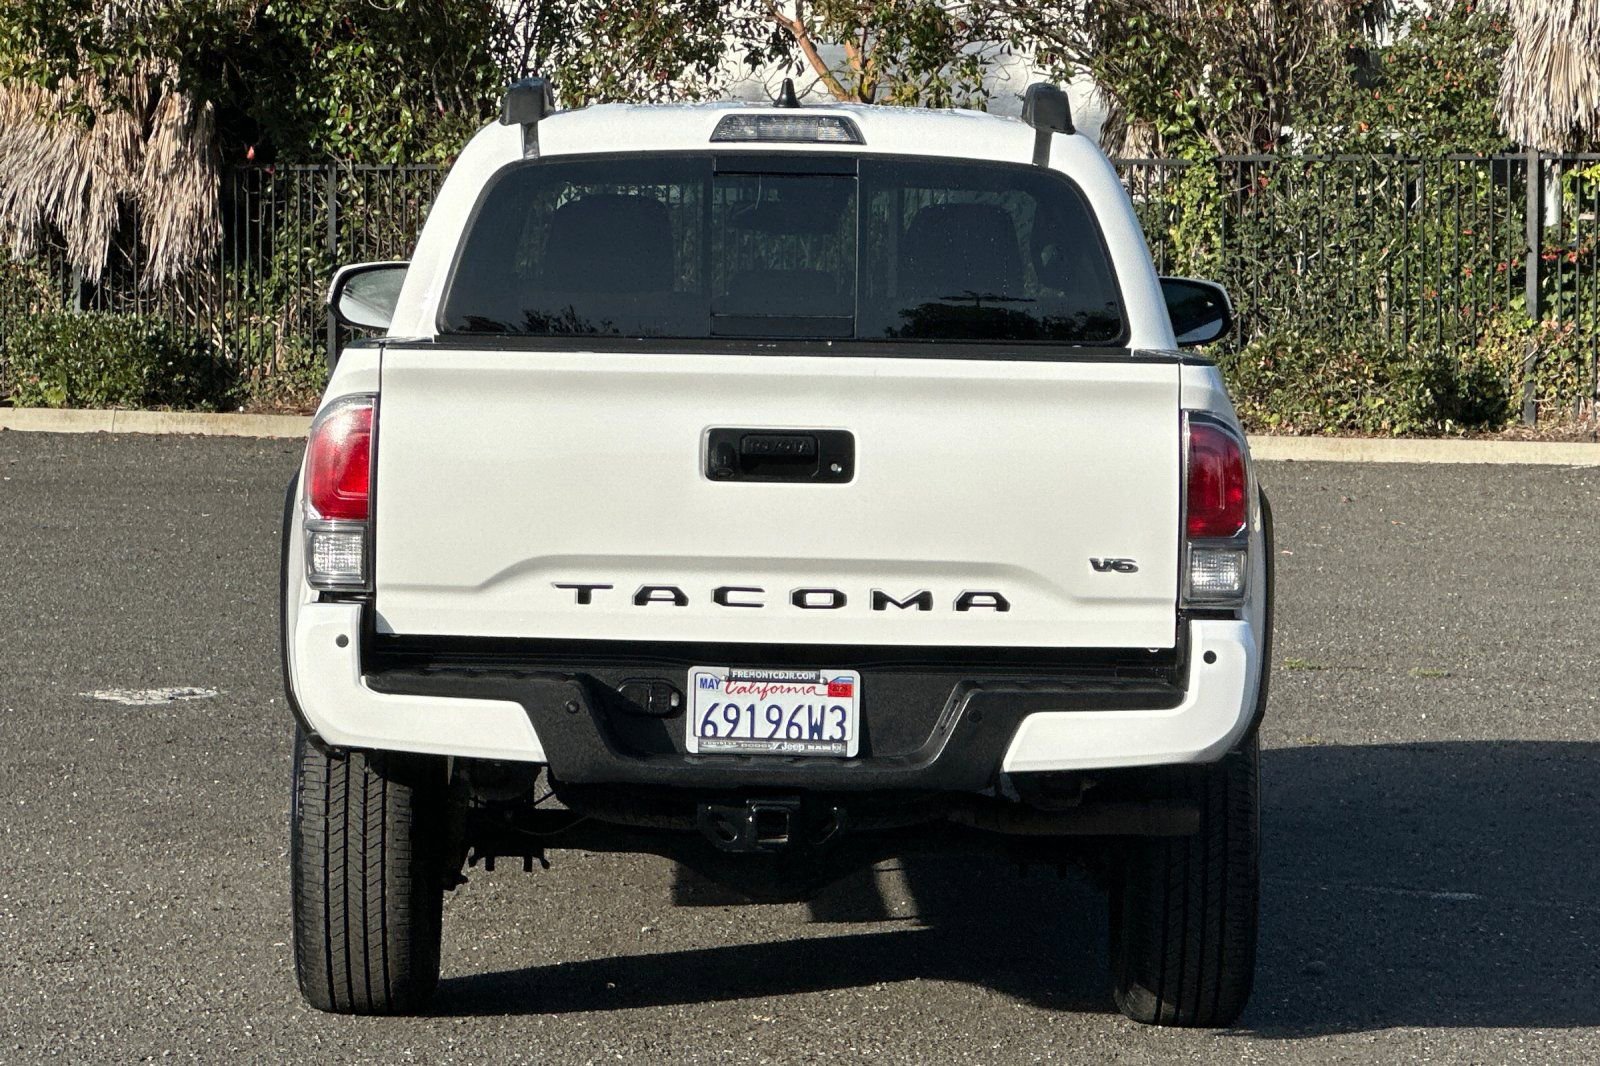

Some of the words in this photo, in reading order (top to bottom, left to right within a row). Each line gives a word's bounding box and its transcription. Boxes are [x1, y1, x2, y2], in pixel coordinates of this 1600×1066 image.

[1088, 557, 1139, 573] V6
[552, 580, 1011, 612] TACOMA
[732, 670, 816, 680] FREMONTCDJR.COM
[699, 677, 721, 690] MAY
[724, 677, 828, 701] California
[700, 702, 847, 742] 69196W3
[781, 741, 805, 752] Jeep
